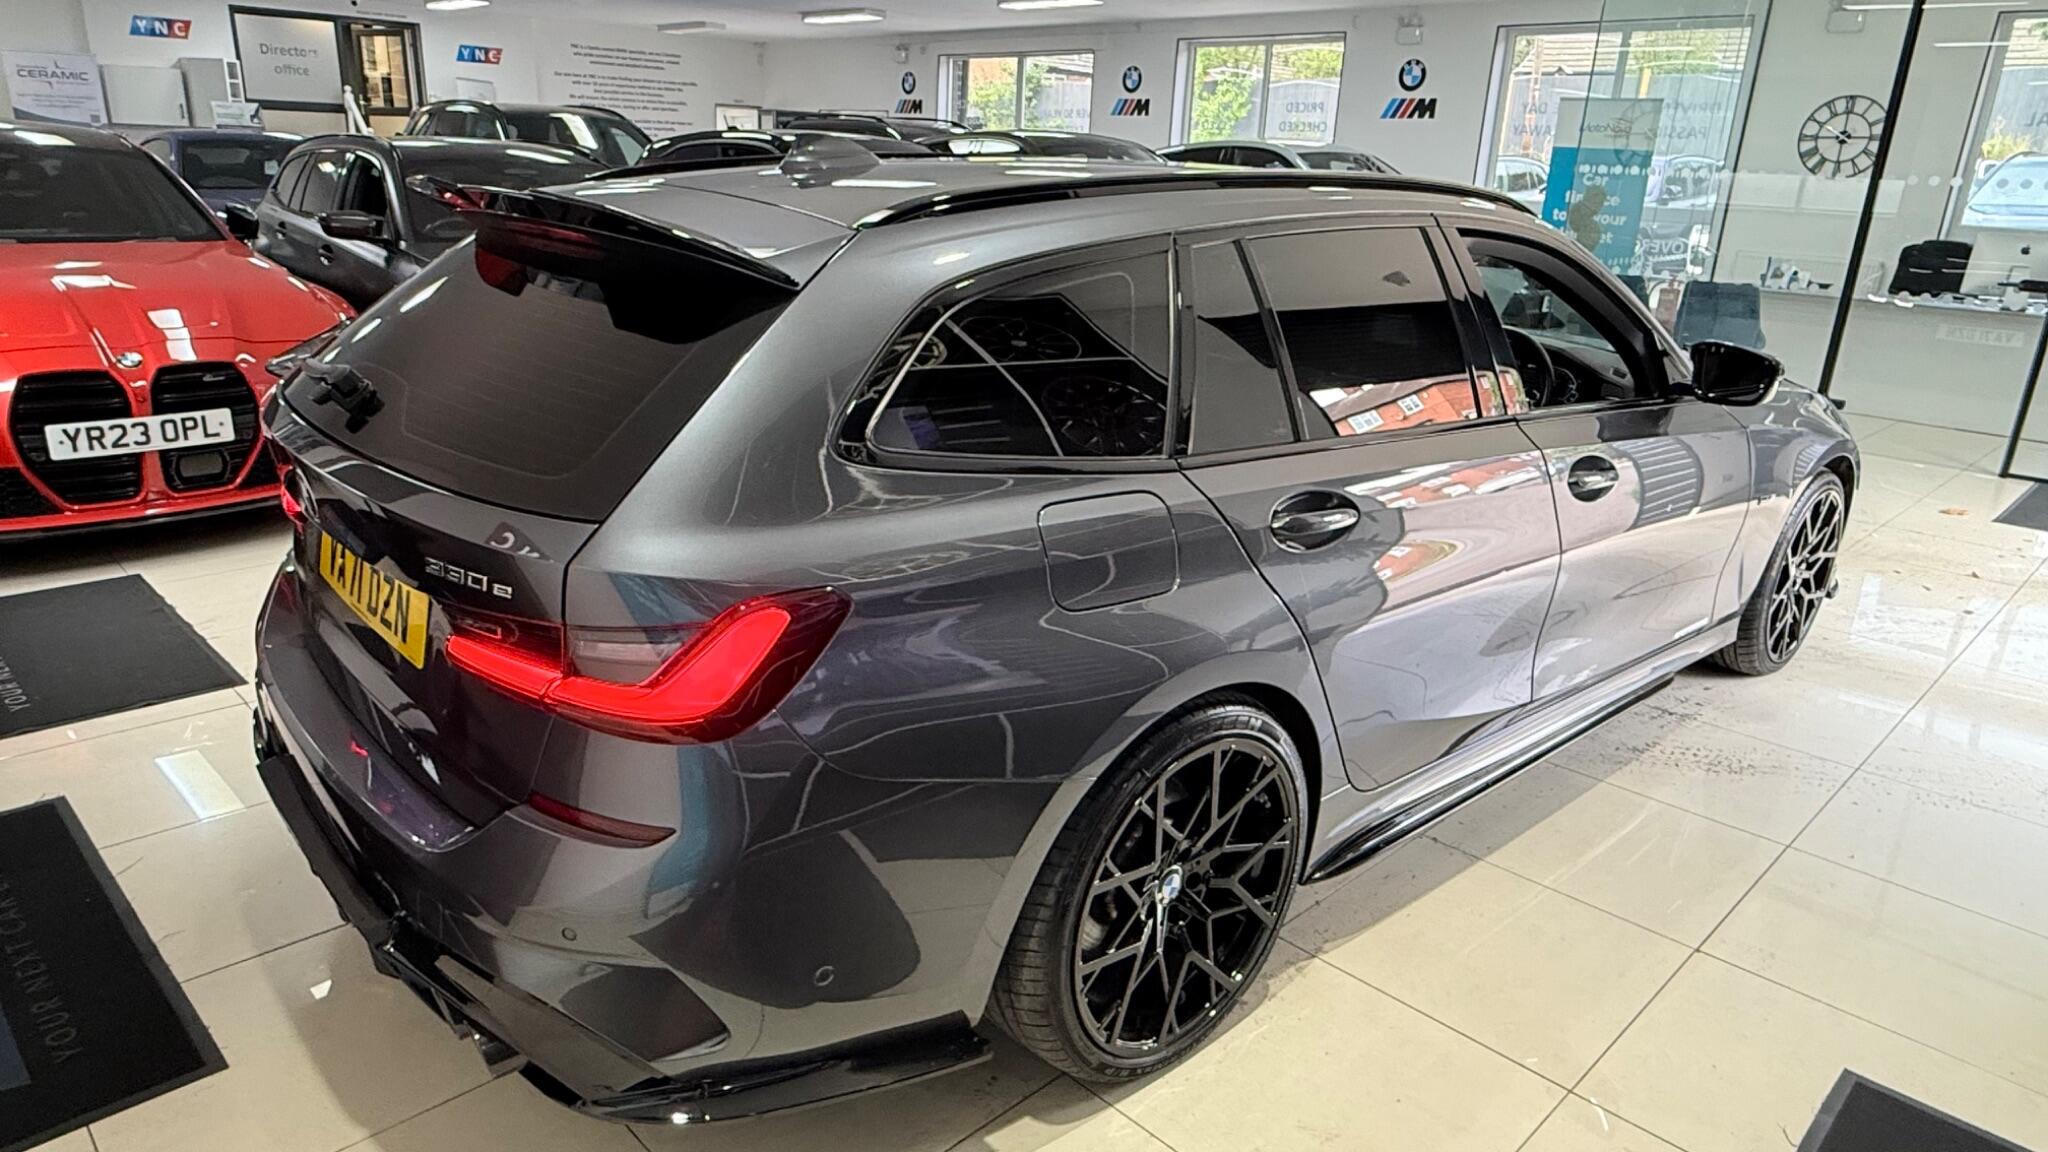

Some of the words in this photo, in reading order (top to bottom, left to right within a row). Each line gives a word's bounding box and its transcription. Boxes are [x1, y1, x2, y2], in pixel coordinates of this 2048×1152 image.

[134, 18, 188, 38] YNC
[460, 46, 500, 63] YNC
[16, 67, 90, 82] CERAMIC
[273, 63, 311, 77] office
[1583, 173, 1609, 186] Car
[1552, 207, 1568, 221] to
[60, 421, 151, 453] YR23
[160, 414, 221, 443] OPL
[424, 556, 513, 599] 330e
[368, 565, 412, 644] DZN
[5, 940, 50, 994] NEXT
[31, 995, 85, 1065] YOUR
